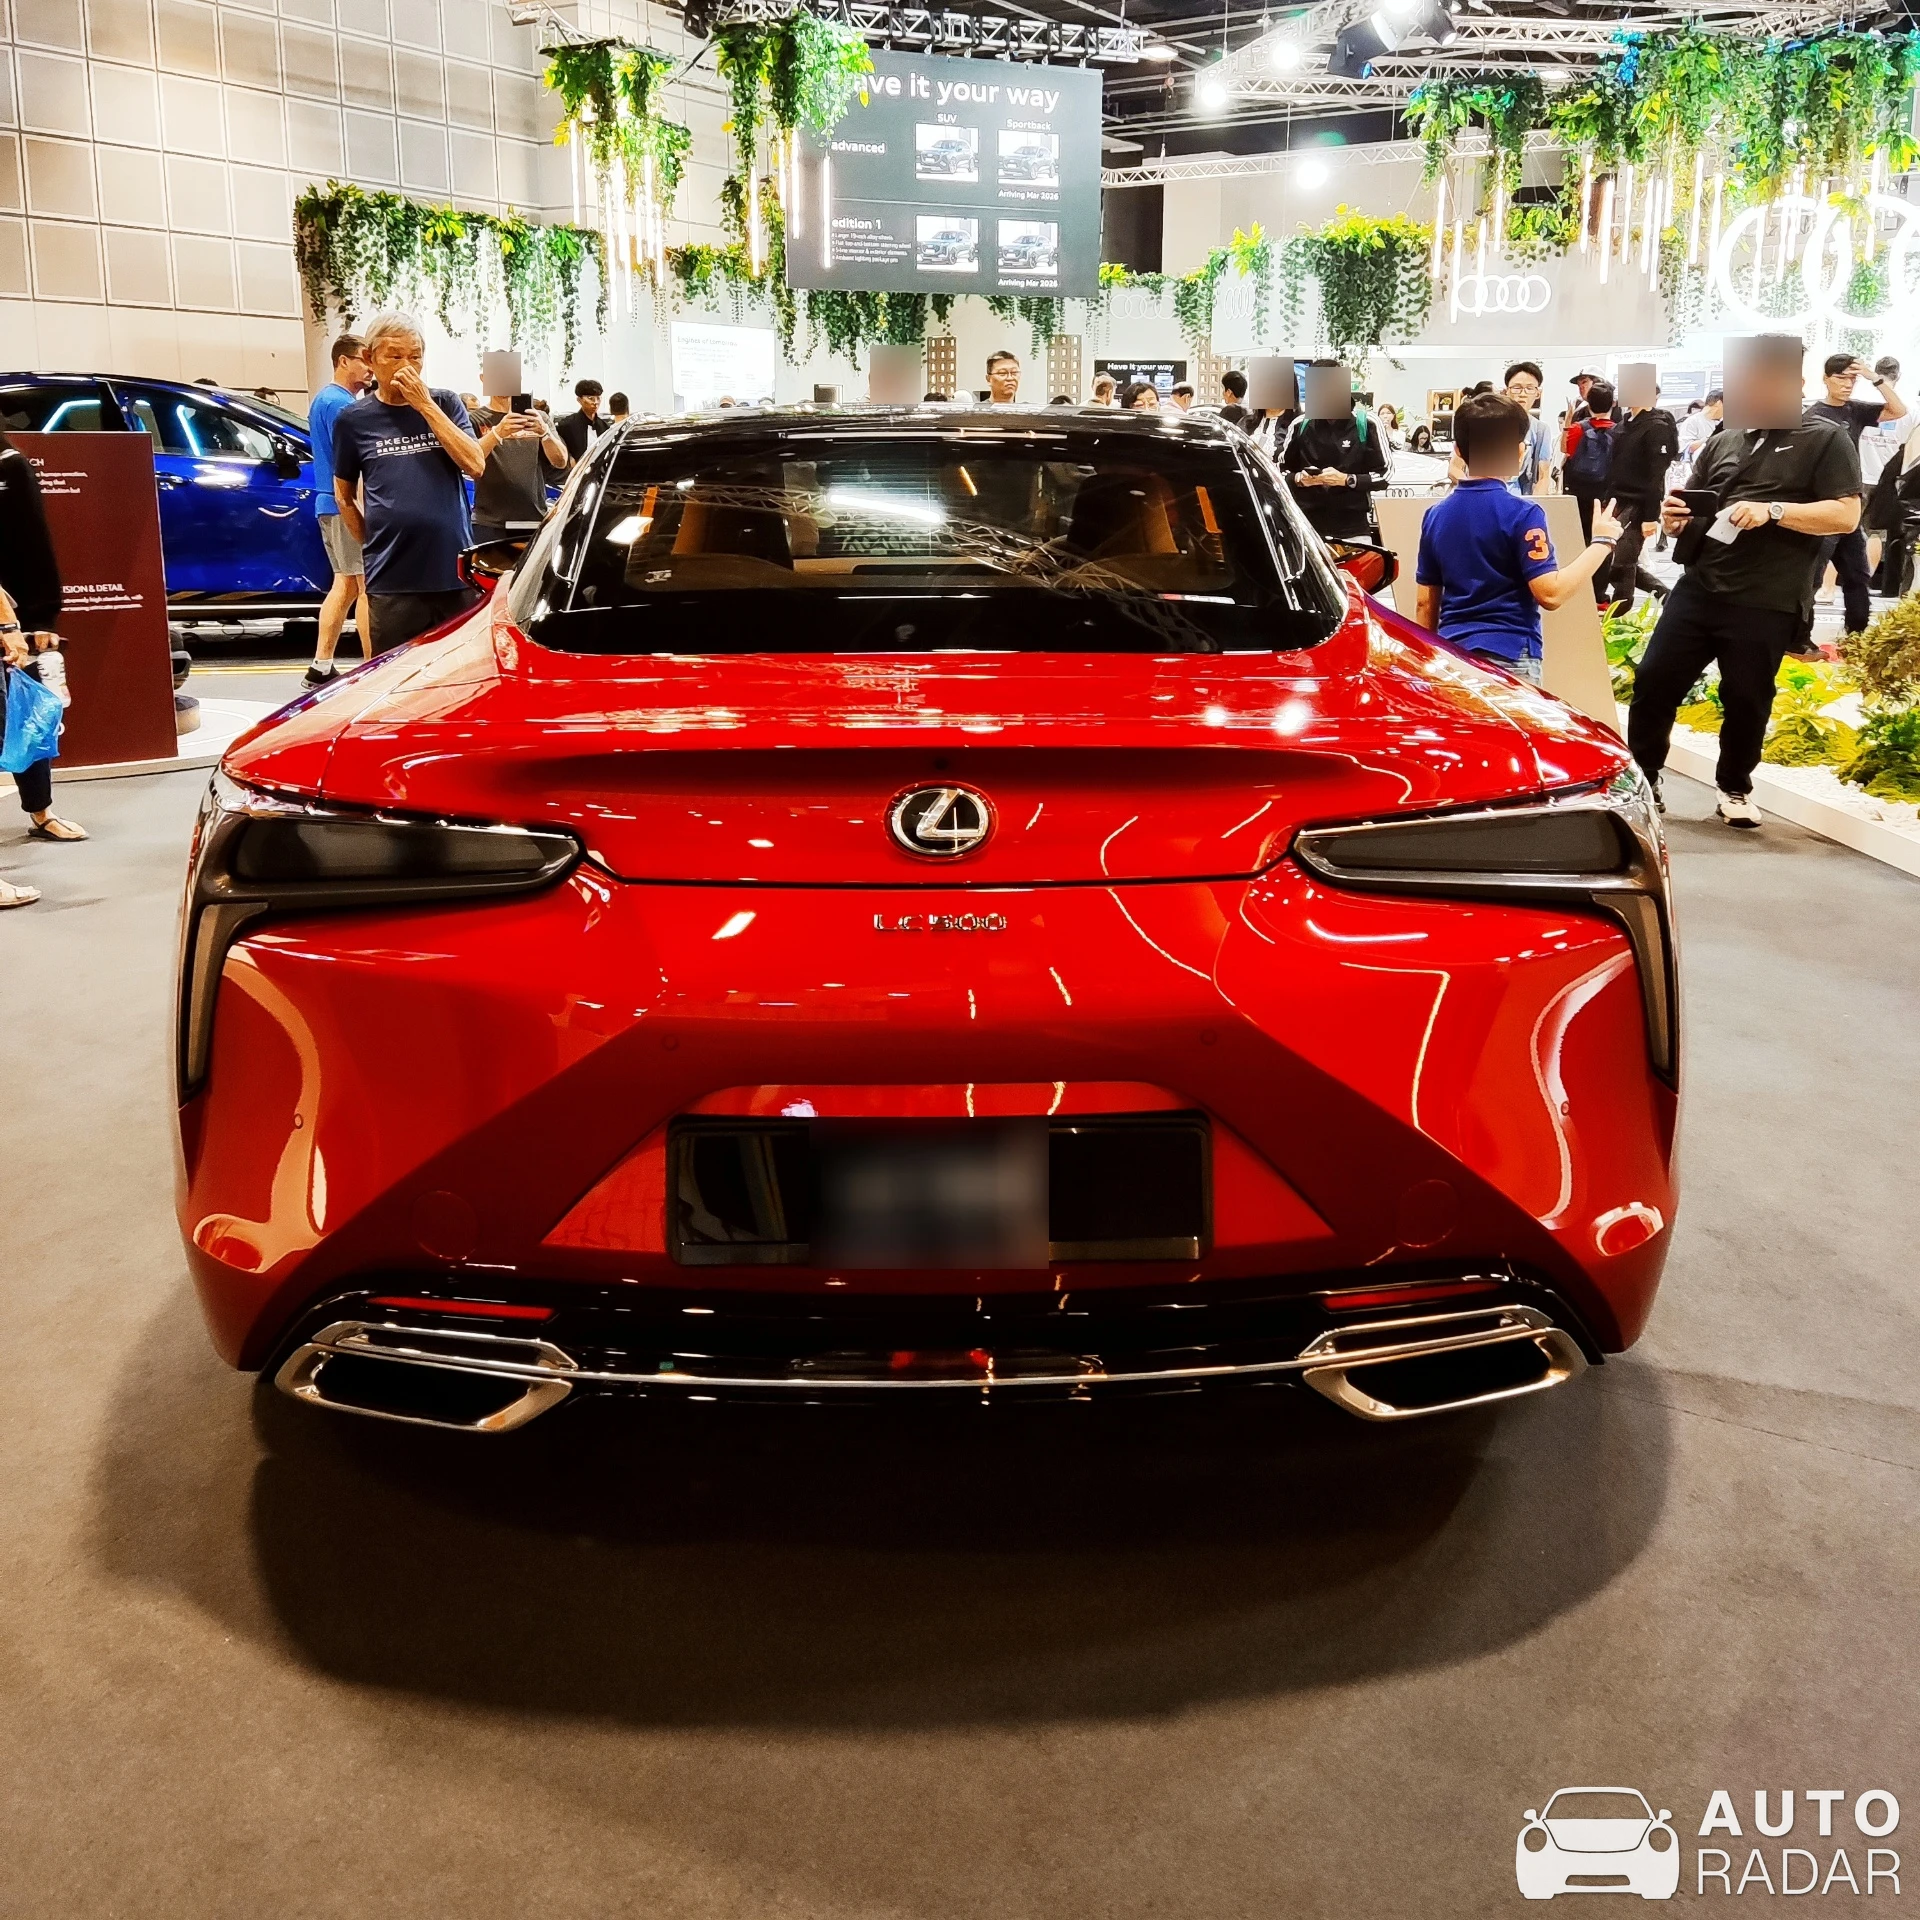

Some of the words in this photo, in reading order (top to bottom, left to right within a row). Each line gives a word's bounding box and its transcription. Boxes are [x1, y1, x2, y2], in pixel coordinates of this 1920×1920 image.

[854, 74, 901, 96] ave
[910, 71, 931, 98] it
[936, 80, 1000, 106] your
[1006, 86, 1060, 114] way
[937, 113, 958, 124] SUV
[1006, 118, 1052, 131] Sportback
[831, 139, 886, 154] advanced
[998, 189, 1025, 200] Arriving
[1026, 191, 1040, 200] Mar
[1040, 191, 1060, 201] 2026
[831, 217, 873, 230] edition
[875, 218, 882, 230] 1
[997, 278, 1025, 288] Arriving
[1025, 279, 1039, 287] Mar
[1107, 363, 1128, 371] Have
[1129, 363, 1136, 371] it
[1157, 364, 1174, 372] way
[375, 432, 436, 447] SKECHER
[376, 441, 440, 453] PERFORMANC
[1524, 527, 1550, 561] 3
[62, 584, 88, 594] ISION
[88, 584, 95, 593] &
[96, 583, 125, 592] DETAIL
[873, 913, 924, 931] LC
[928, 912, 1008, 931] 500
